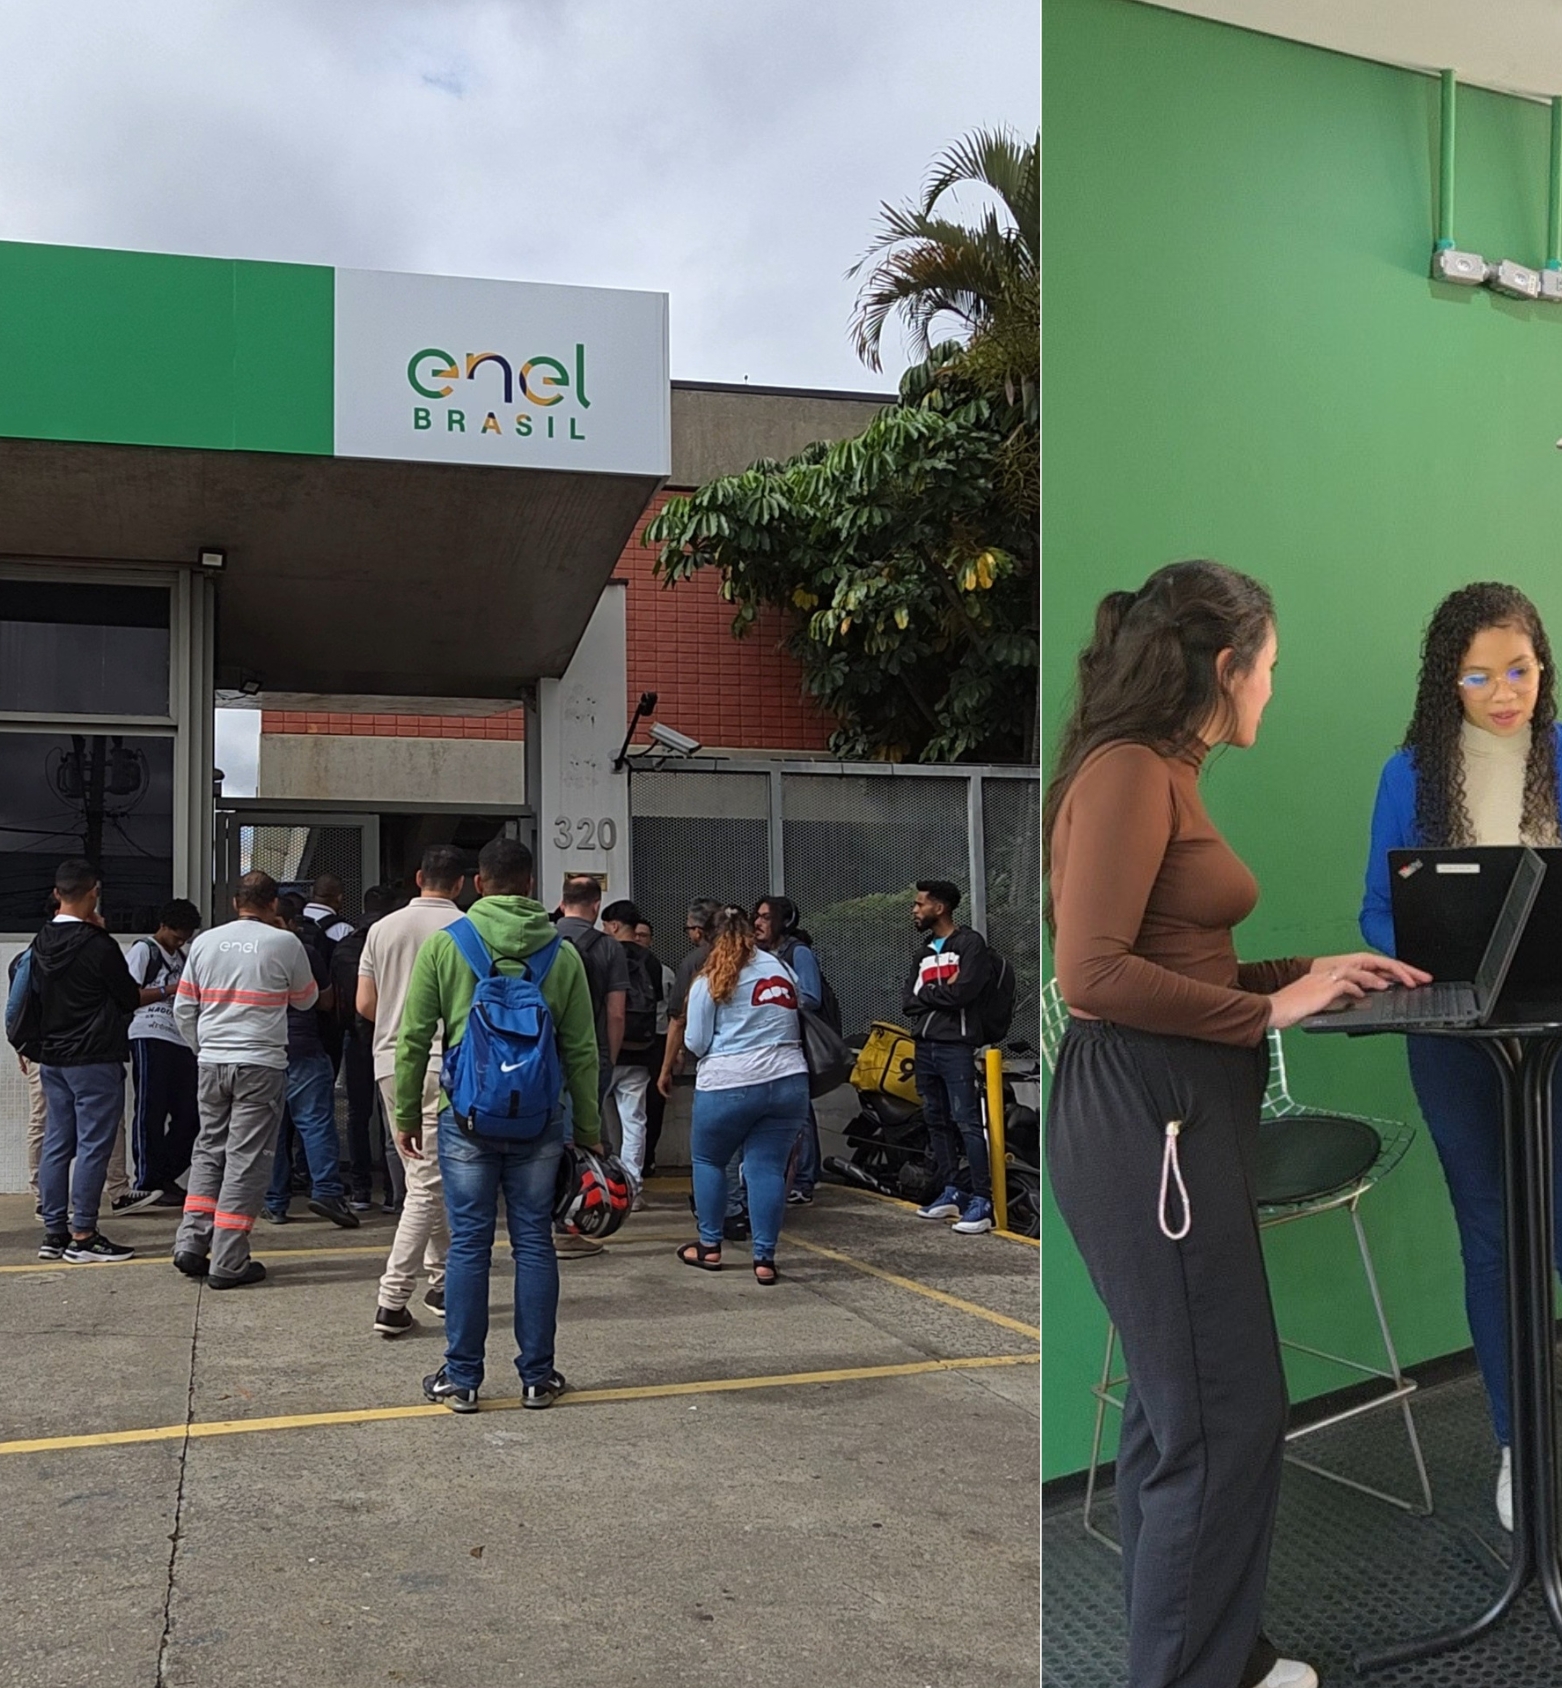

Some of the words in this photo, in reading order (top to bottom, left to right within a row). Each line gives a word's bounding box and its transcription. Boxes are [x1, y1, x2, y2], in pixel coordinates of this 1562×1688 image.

[407, 343, 591, 409] enel
[413, 406, 586, 440] BRASIL
[553, 815, 617, 850] 320
[219, 939, 259, 954] enel
